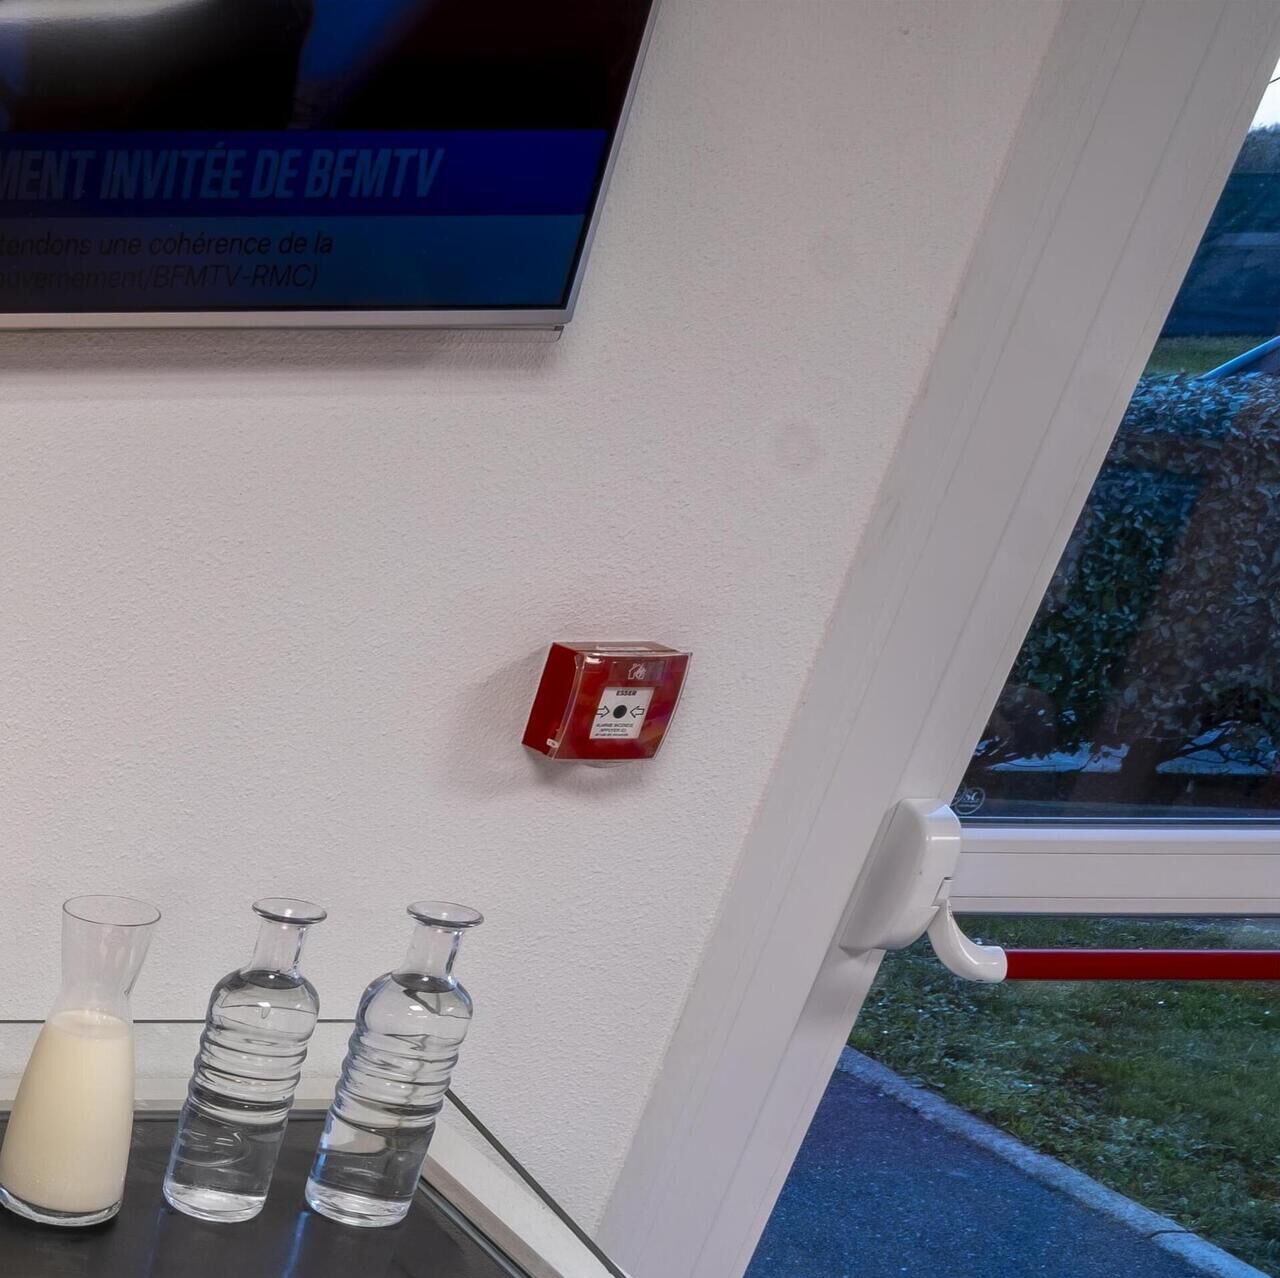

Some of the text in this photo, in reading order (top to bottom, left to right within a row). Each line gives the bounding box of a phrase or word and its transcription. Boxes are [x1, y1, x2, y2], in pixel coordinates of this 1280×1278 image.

[98, 141, 248, 200] INVITÉE
[250, 147, 303, 199] DE
[305, 147, 447, 199] BFMTV
[98, 236, 142, 256] une
[149, 231, 271, 256] cohérence
[278, 231, 310, 256] de
[313, 231, 334, 255] la
